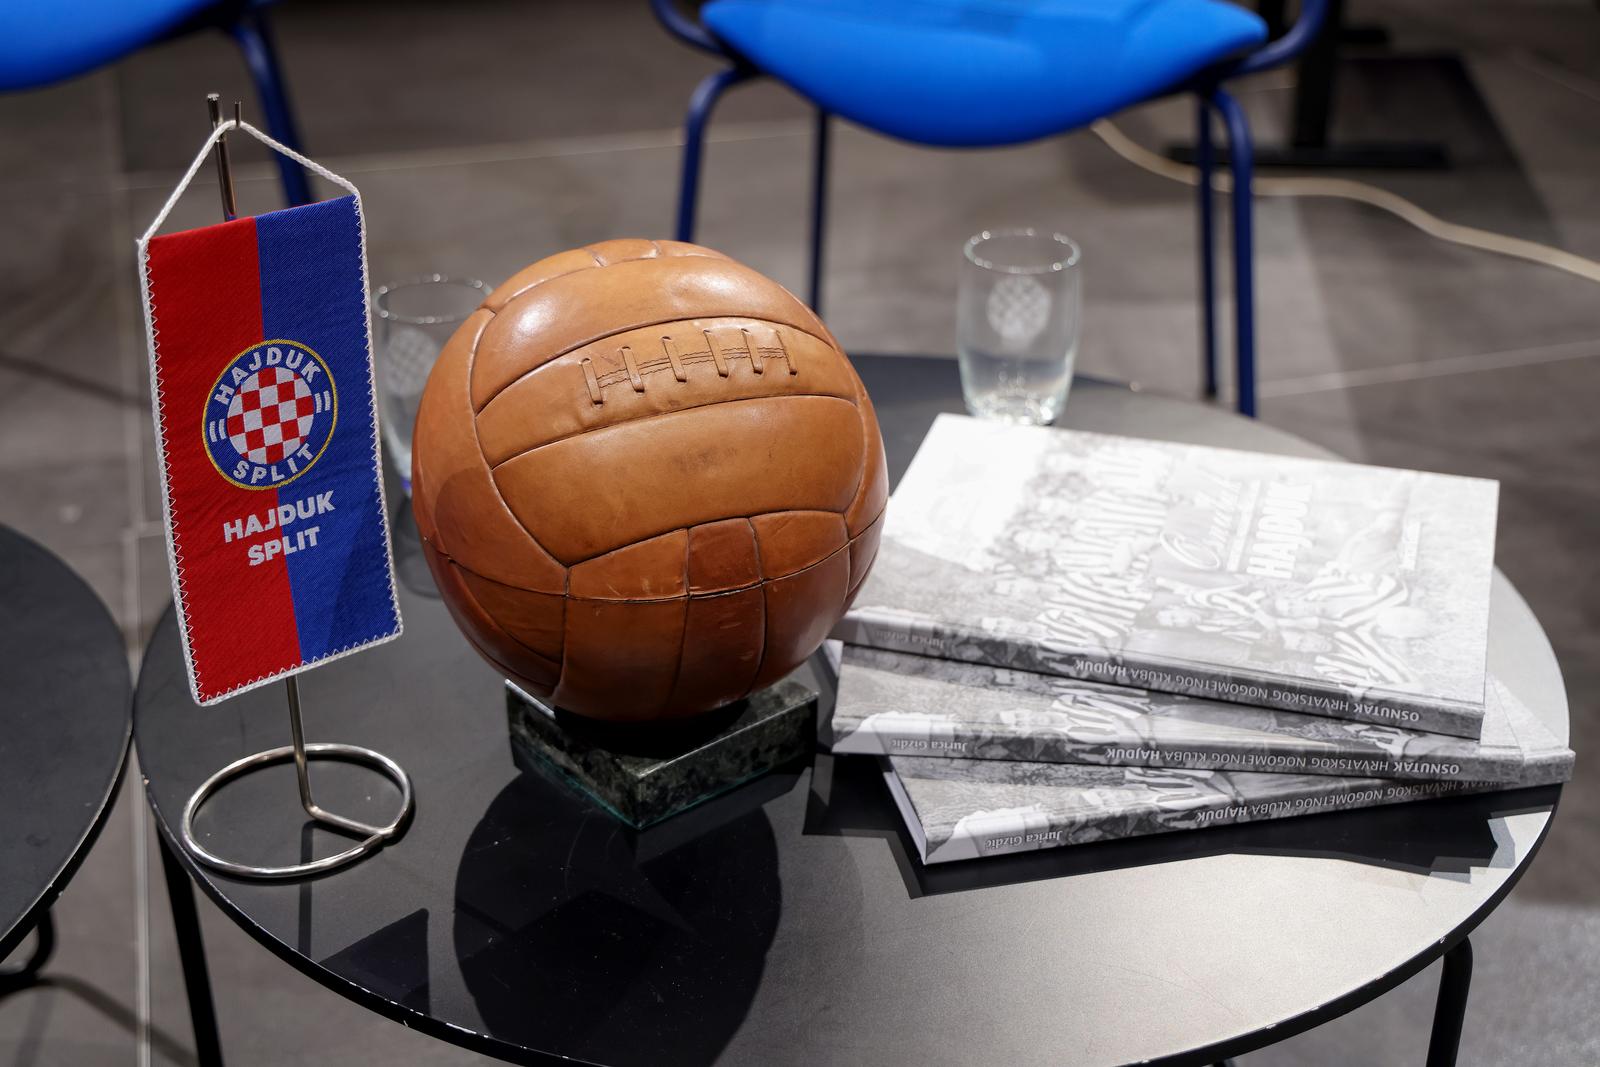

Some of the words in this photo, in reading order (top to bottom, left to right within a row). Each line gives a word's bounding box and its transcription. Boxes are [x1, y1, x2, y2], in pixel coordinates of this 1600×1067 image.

[214, 347, 321, 405] HAJDUK
[233, 443, 314, 484] SPLIT
[223, 490, 336, 543] HAJDUK
[247, 526, 321, 566] SPLIT
[1075, 659, 1127, 676] HAJDUK
[1130, 668, 1171, 684] KLUBA
[1175, 674, 1268, 699] NOGOMETNOG
[1272, 690, 1349, 711] HRVATSKOG
[1353, 702, 1420, 722] OSNUTAK
[931, 741, 968, 752] Jurica
[1105, 747, 1160, 760] HAJDUK
[1164, 750, 1206, 762] KLUBA
[1211, 752, 1306, 767] NOGOMETNOG
[1310, 756, 1389, 771] HRVATSKOG
[1393, 760, 1460, 774] OSNUTAK
[1387, 780, 1458, 798] HRVATSKOG
[1251, 800, 1291, 815] KLUBA
[1295, 790, 1384, 810] NOGOMETNOG
[1196, 805, 1248, 822] HAJDUK
[1026, 830, 1063, 844] Jurica
